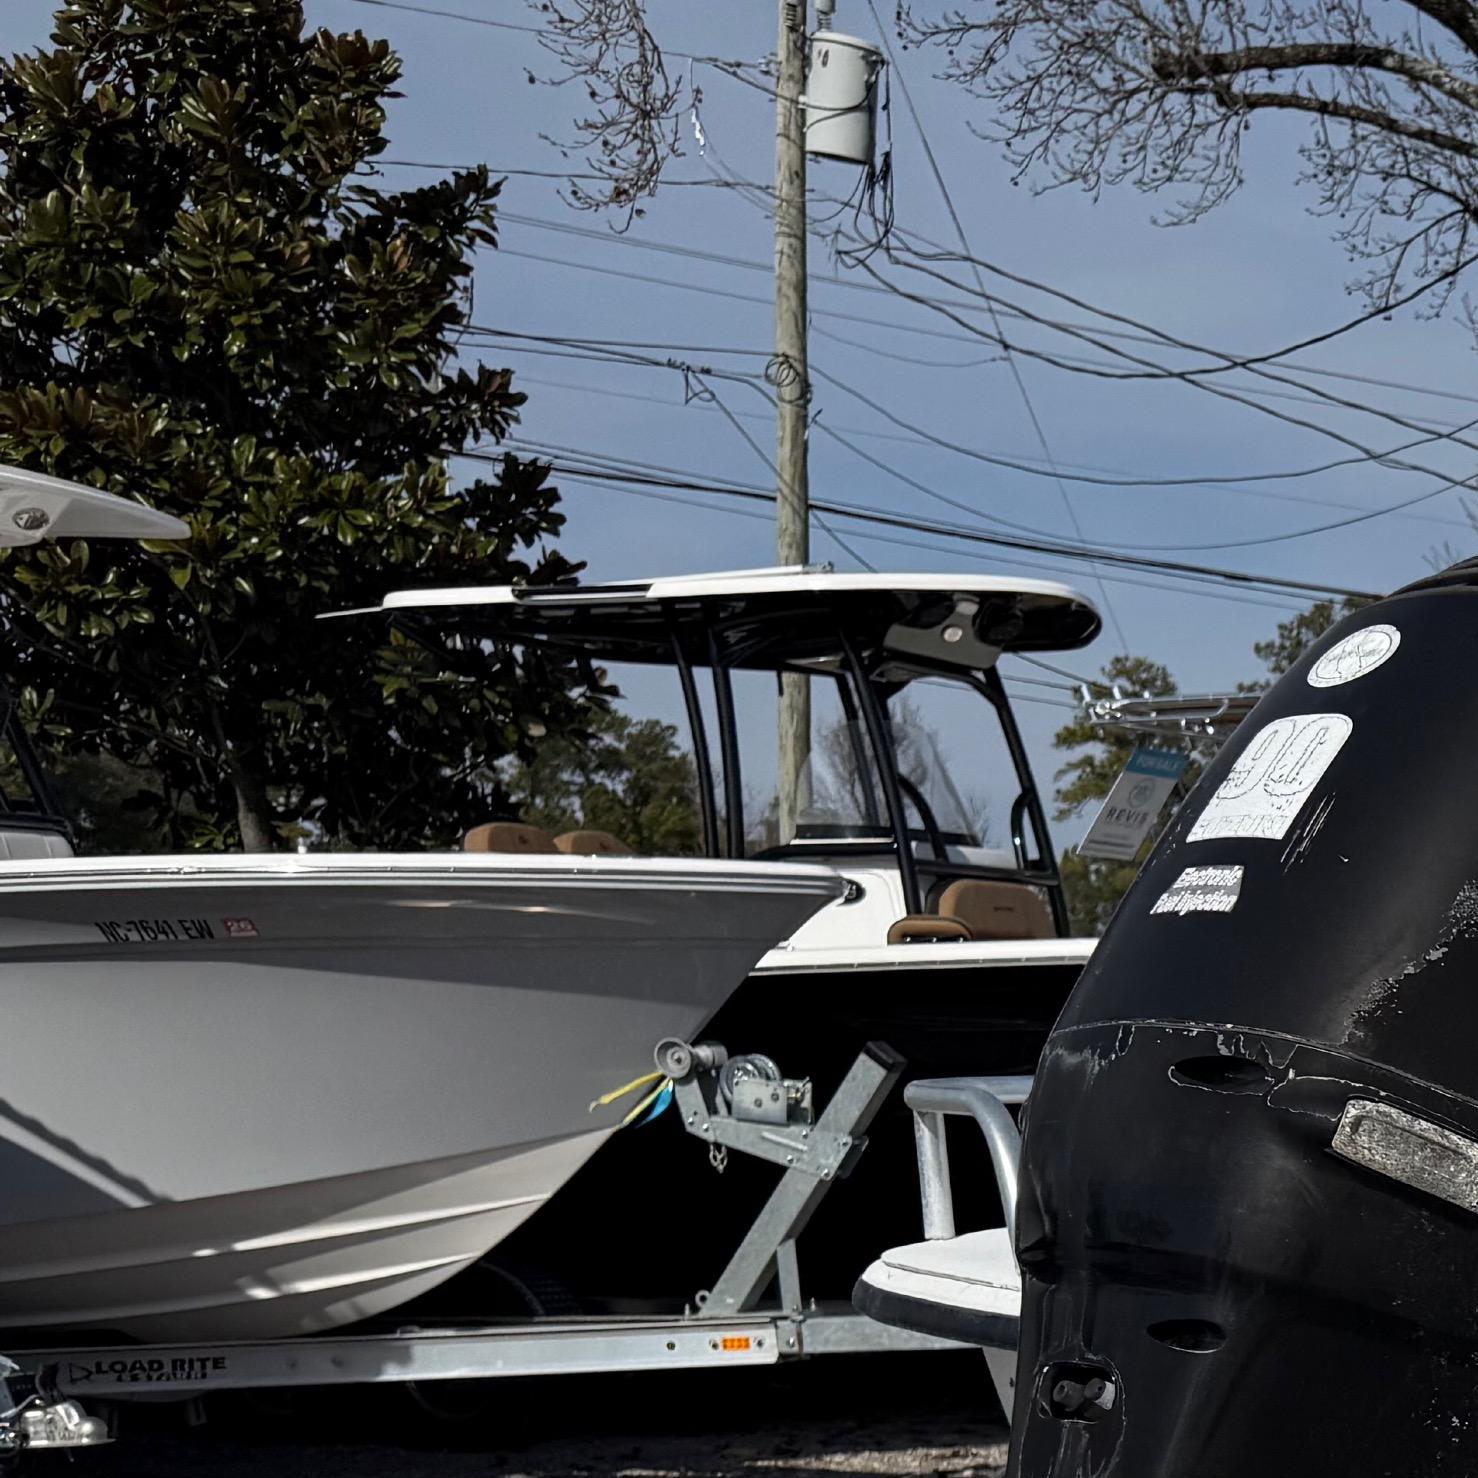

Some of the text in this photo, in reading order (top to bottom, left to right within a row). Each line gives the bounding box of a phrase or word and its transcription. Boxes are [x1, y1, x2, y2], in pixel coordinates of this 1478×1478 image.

[1172, 865, 1246, 888] Electronic
[94, 918, 214, 943] NC-7641 EW
[95, 1359, 165, 1375] LOAD
